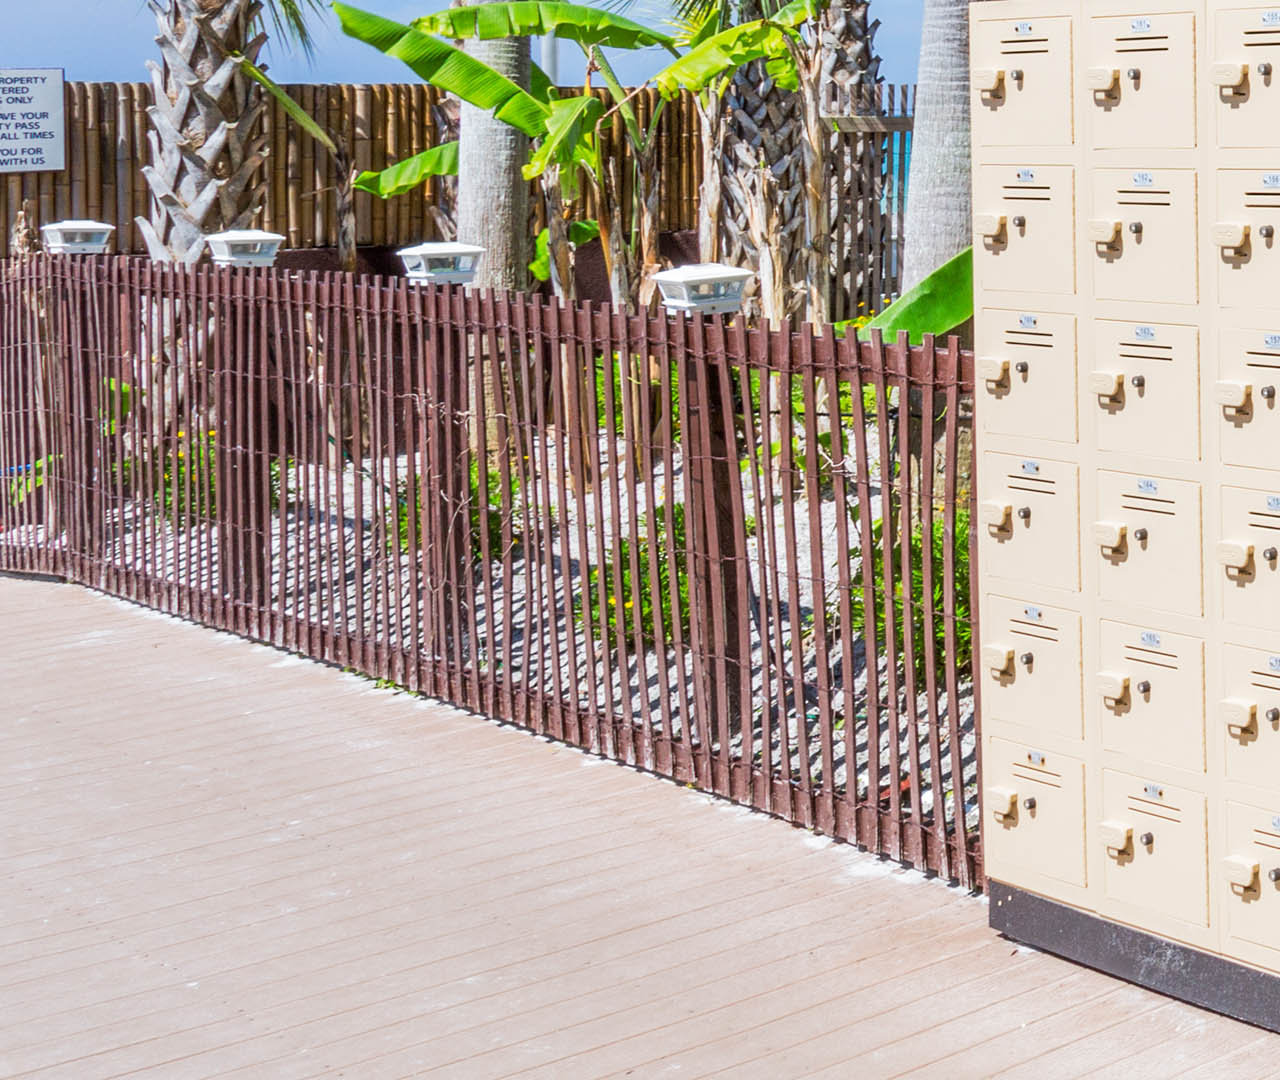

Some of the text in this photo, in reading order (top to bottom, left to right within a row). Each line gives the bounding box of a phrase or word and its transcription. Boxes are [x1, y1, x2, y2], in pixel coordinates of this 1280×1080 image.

[0, 86, 29, 94] ERED
[6, 96, 33, 104] ONLY
[20, 112, 48, 120] YOUR
[15, 121, 40, 129] PASS
[0, 131, 55, 140] ALL TIMES
[21, 147, 43, 155] FOR
[31, 157, 45, 165] US
